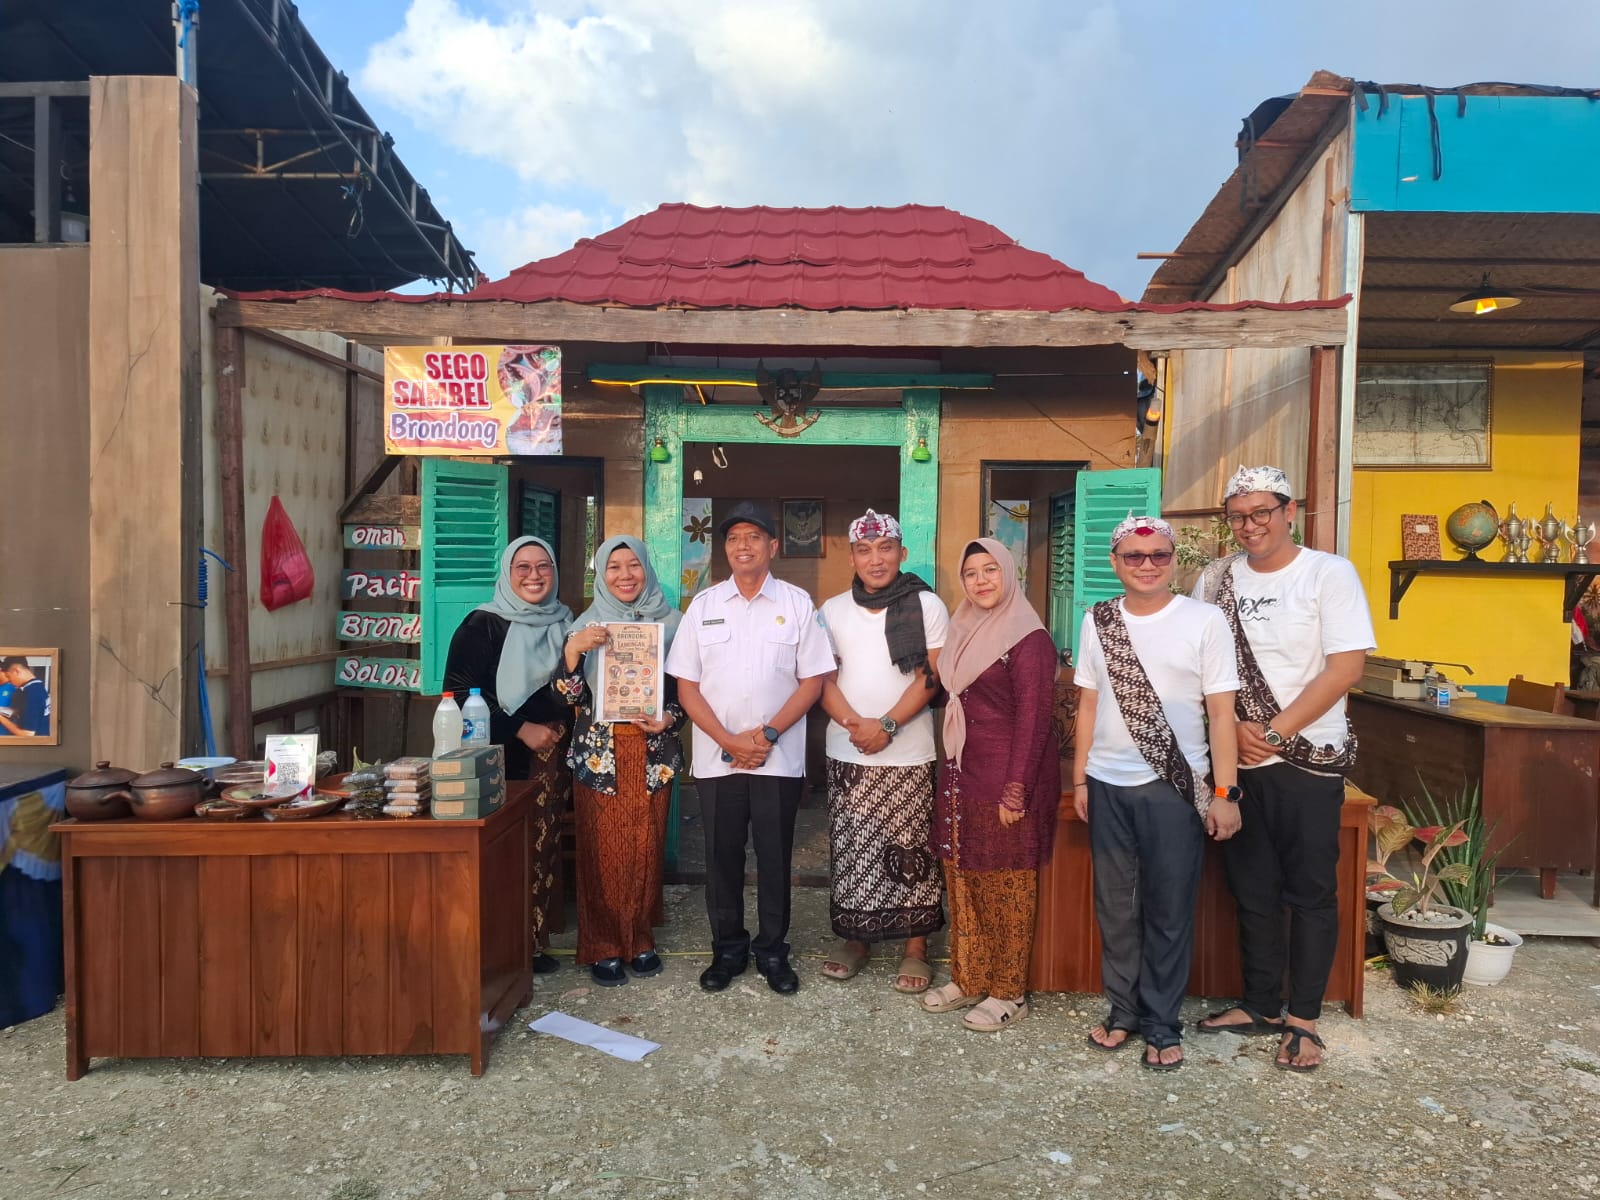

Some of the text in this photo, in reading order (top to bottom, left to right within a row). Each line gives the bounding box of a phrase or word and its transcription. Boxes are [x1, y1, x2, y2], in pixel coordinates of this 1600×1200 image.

[425, 353, 486, 381] SEGO
[393, 381, 489, 407] SAMBEL
[391, 413, 497, 447] Brondong
